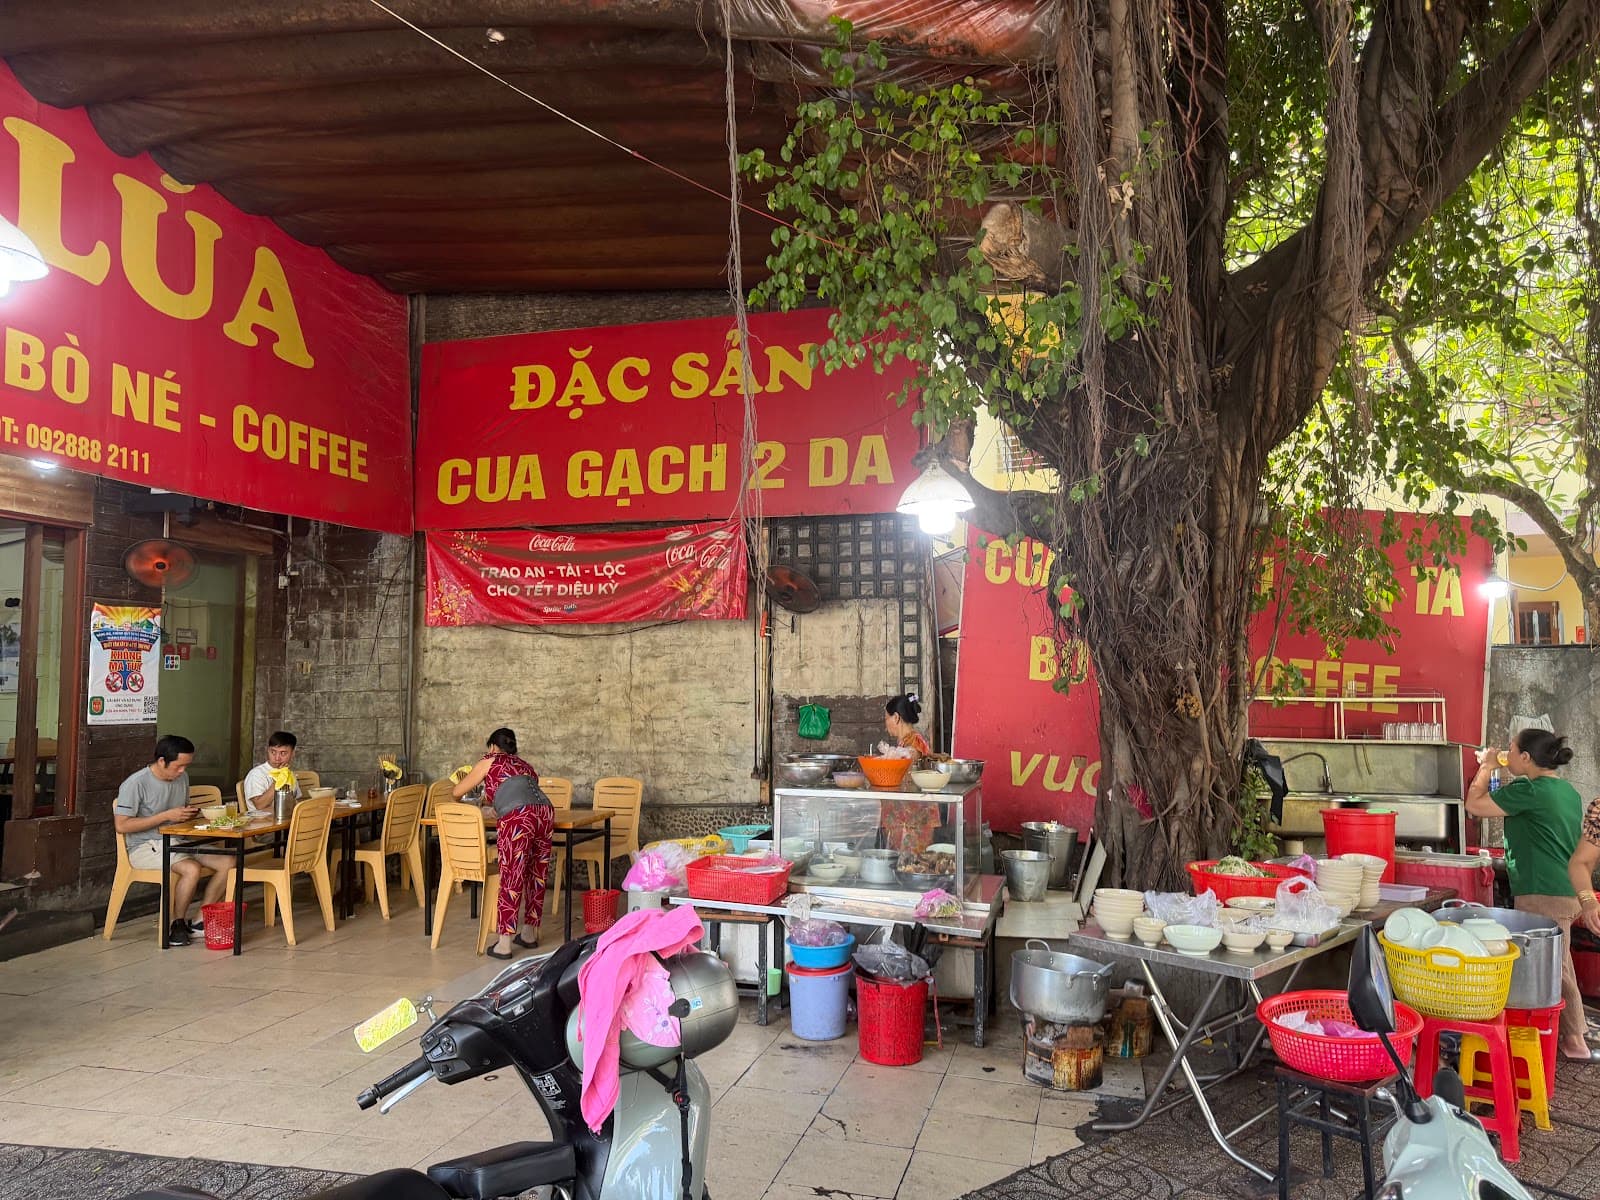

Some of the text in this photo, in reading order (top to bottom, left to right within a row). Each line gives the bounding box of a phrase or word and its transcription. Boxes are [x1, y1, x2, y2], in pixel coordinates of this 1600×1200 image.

[4, 326, 369, 483] BÒ NÉ - COFFEE
[509, 328, 818, 419] ĐẶC SẢN
[0, 416, 149, 474] T: 092888 2111
[437, 433, 895, 506] CUA GẠCH 2 DA
[479, 566, 520, 579] TRAO
[524, 566, 546, 578] AN
[556, 563, 581, 577] TÀI
[594, 562, 626, 579] LỘC
[487, 580, 619, 598] CHO TẾT DIỆU KỲ
